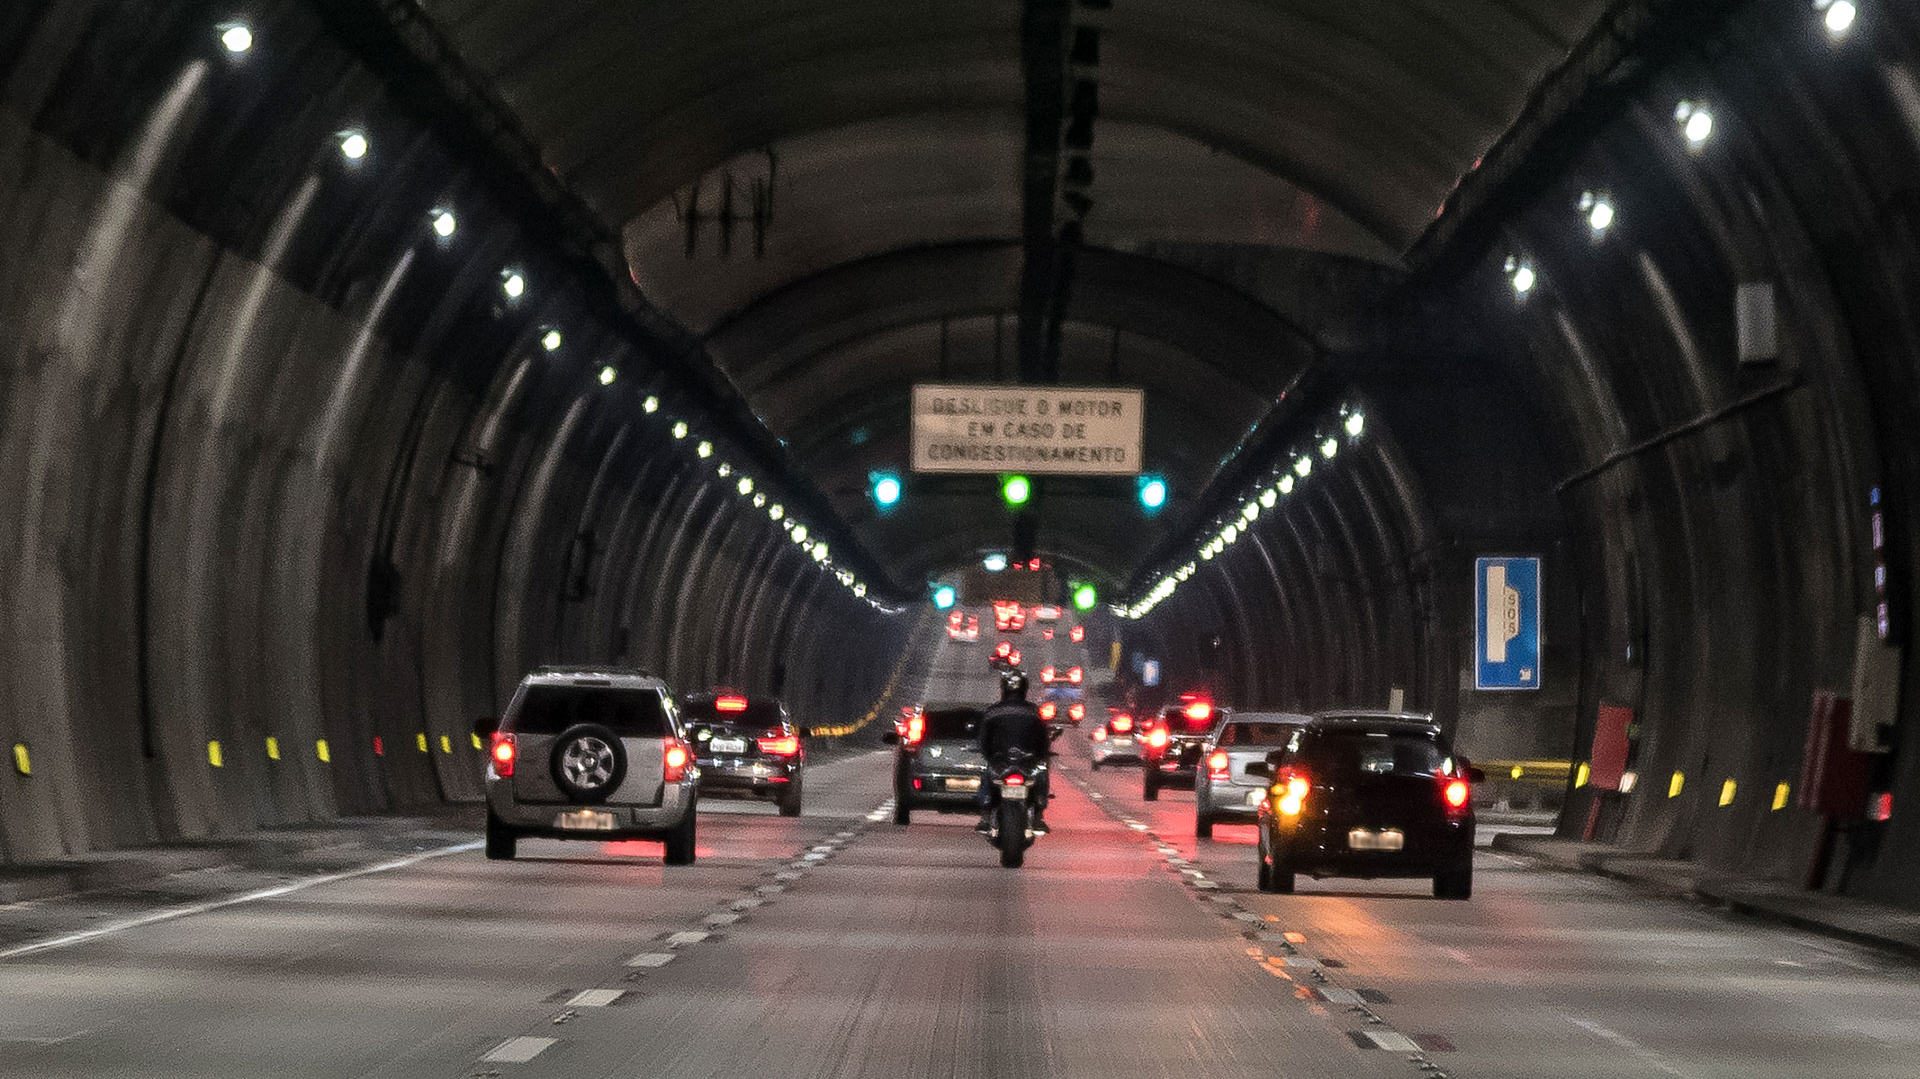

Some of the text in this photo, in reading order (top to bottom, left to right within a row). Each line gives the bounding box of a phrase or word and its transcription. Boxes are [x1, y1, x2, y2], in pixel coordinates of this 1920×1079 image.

[932, 398, 1123, 417] DESLIGUE O MOTOR
[967, 421, 1087, 439] EM CASO DE
[928, 443, 1127, 463] CONGESTIONAMENTO
[1507, 594, 1517, 635] SOS
